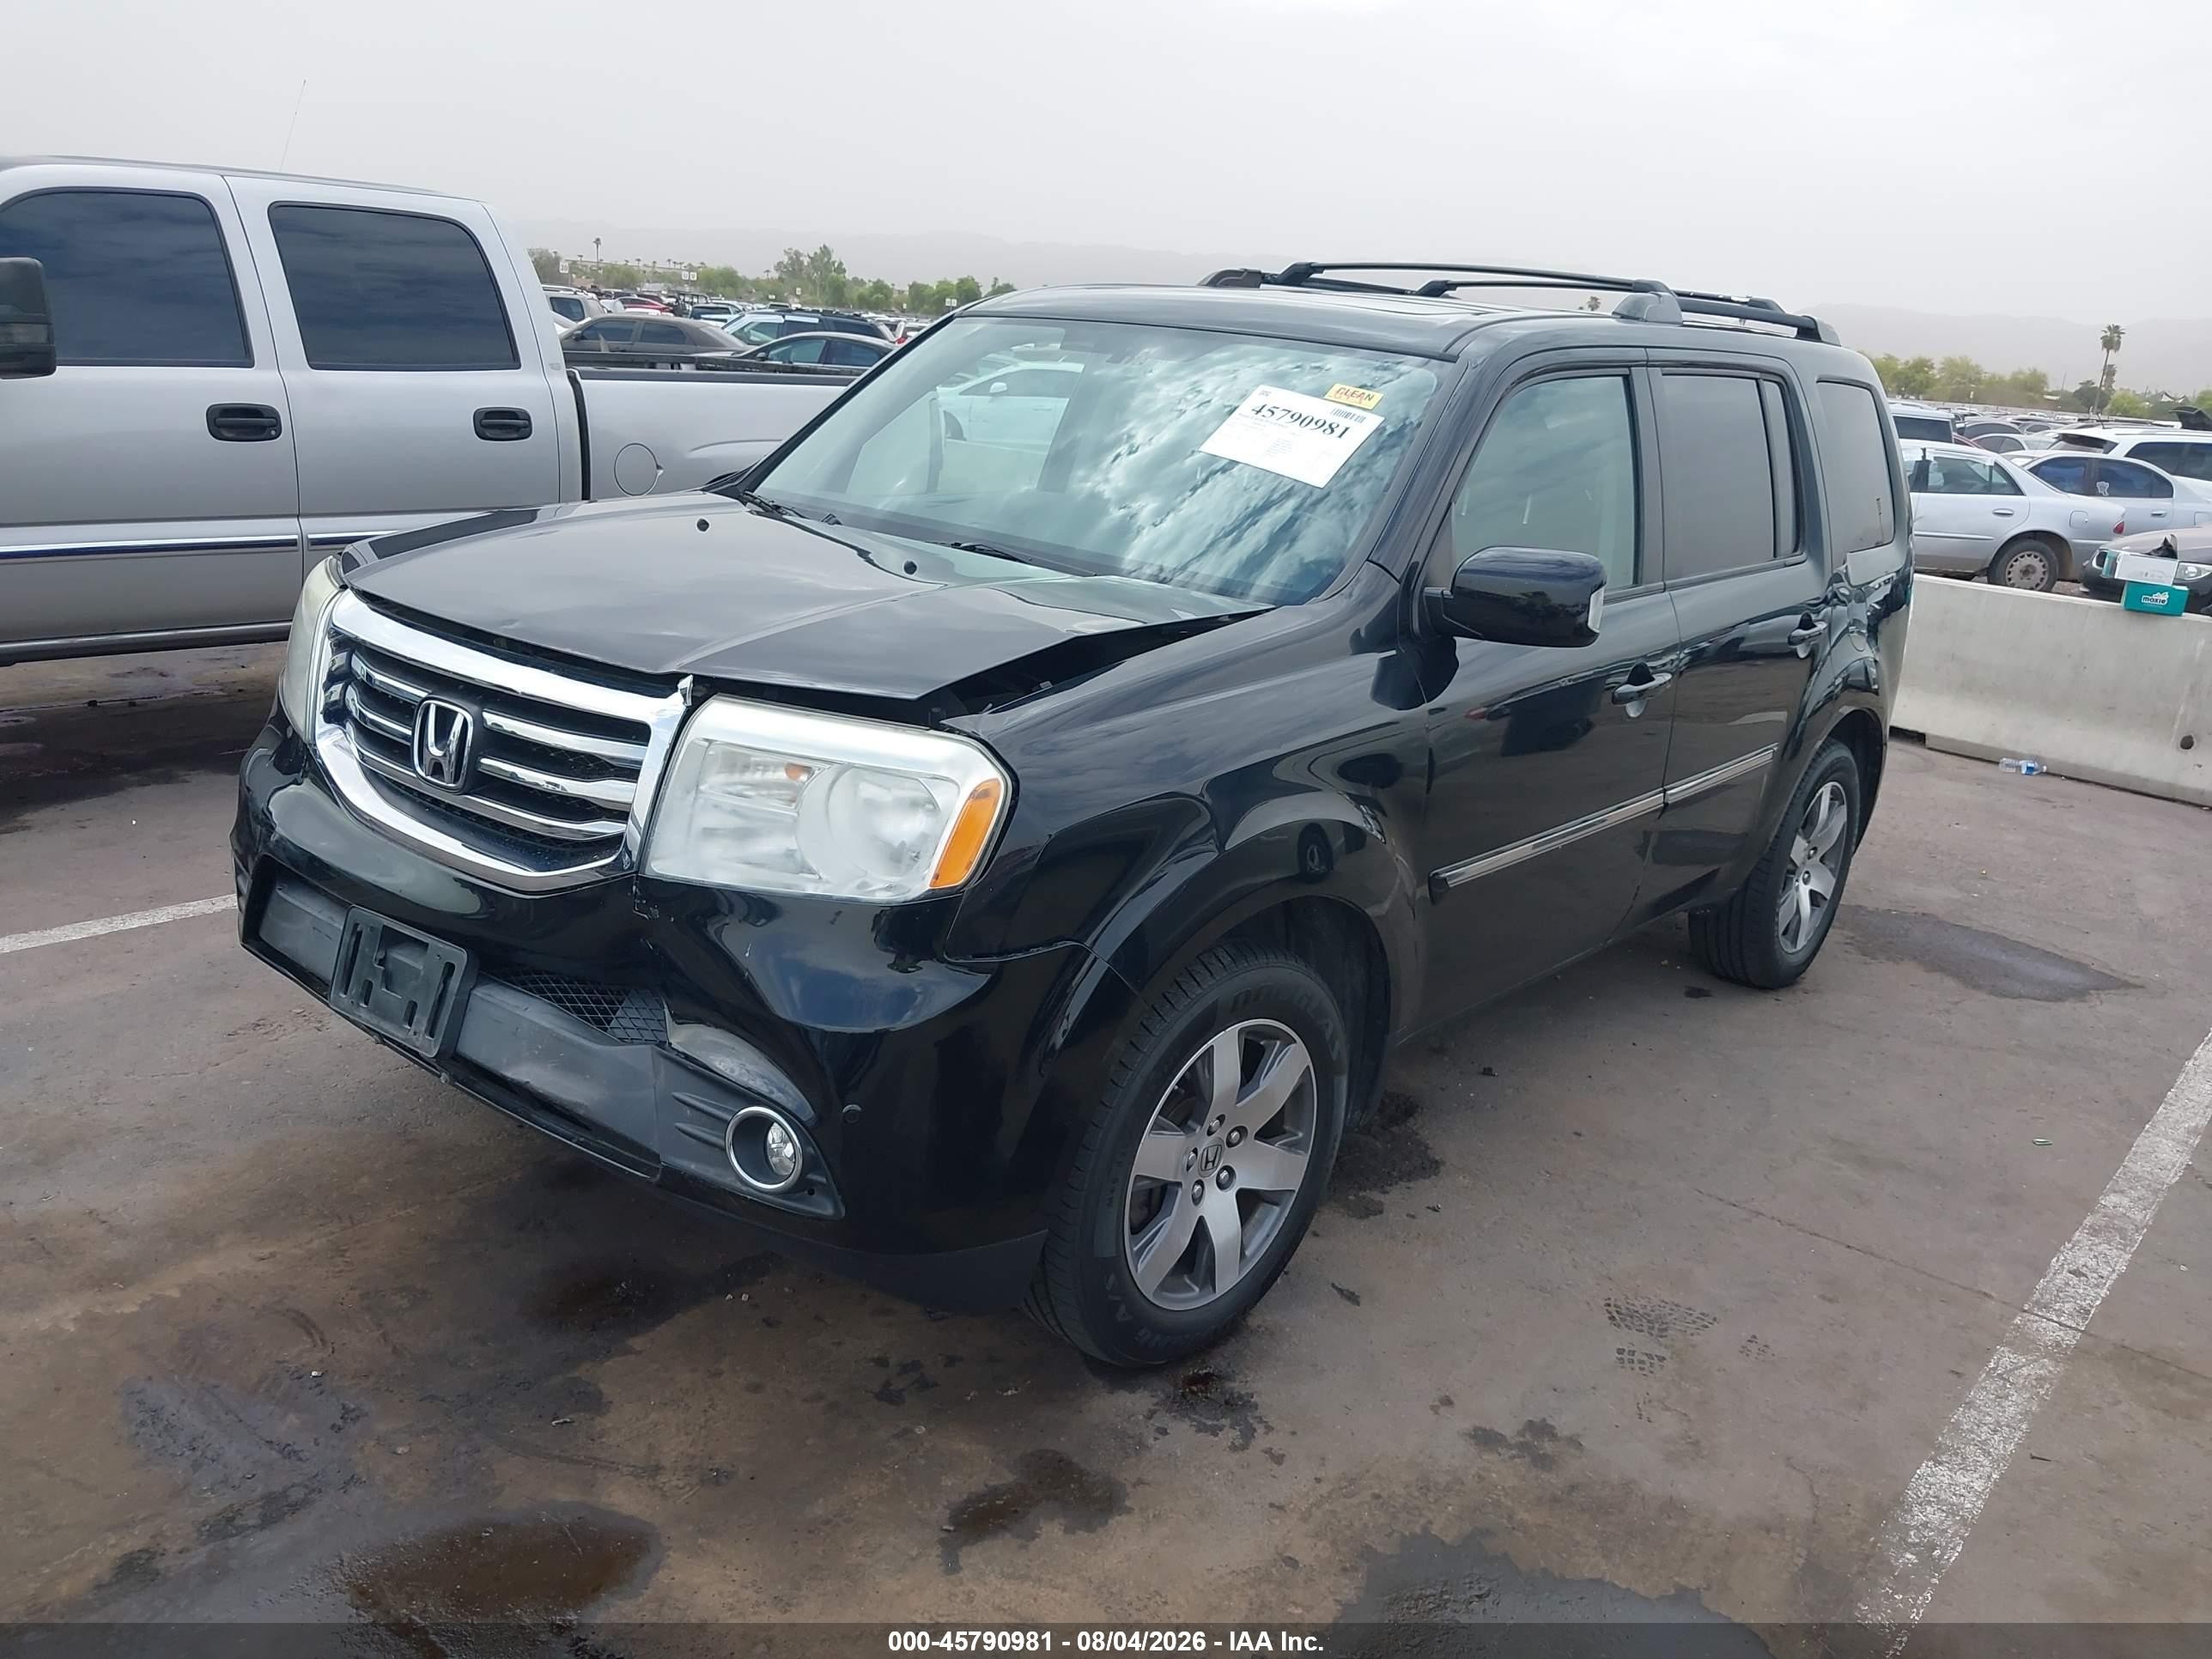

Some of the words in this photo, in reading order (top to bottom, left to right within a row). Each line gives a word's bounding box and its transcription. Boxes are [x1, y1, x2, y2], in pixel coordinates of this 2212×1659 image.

[1334, 386, 1375, 402] CLEAN
[1250, 404, 1350, 439] 45790981
[2142, 596, 2166, 605] moxie
